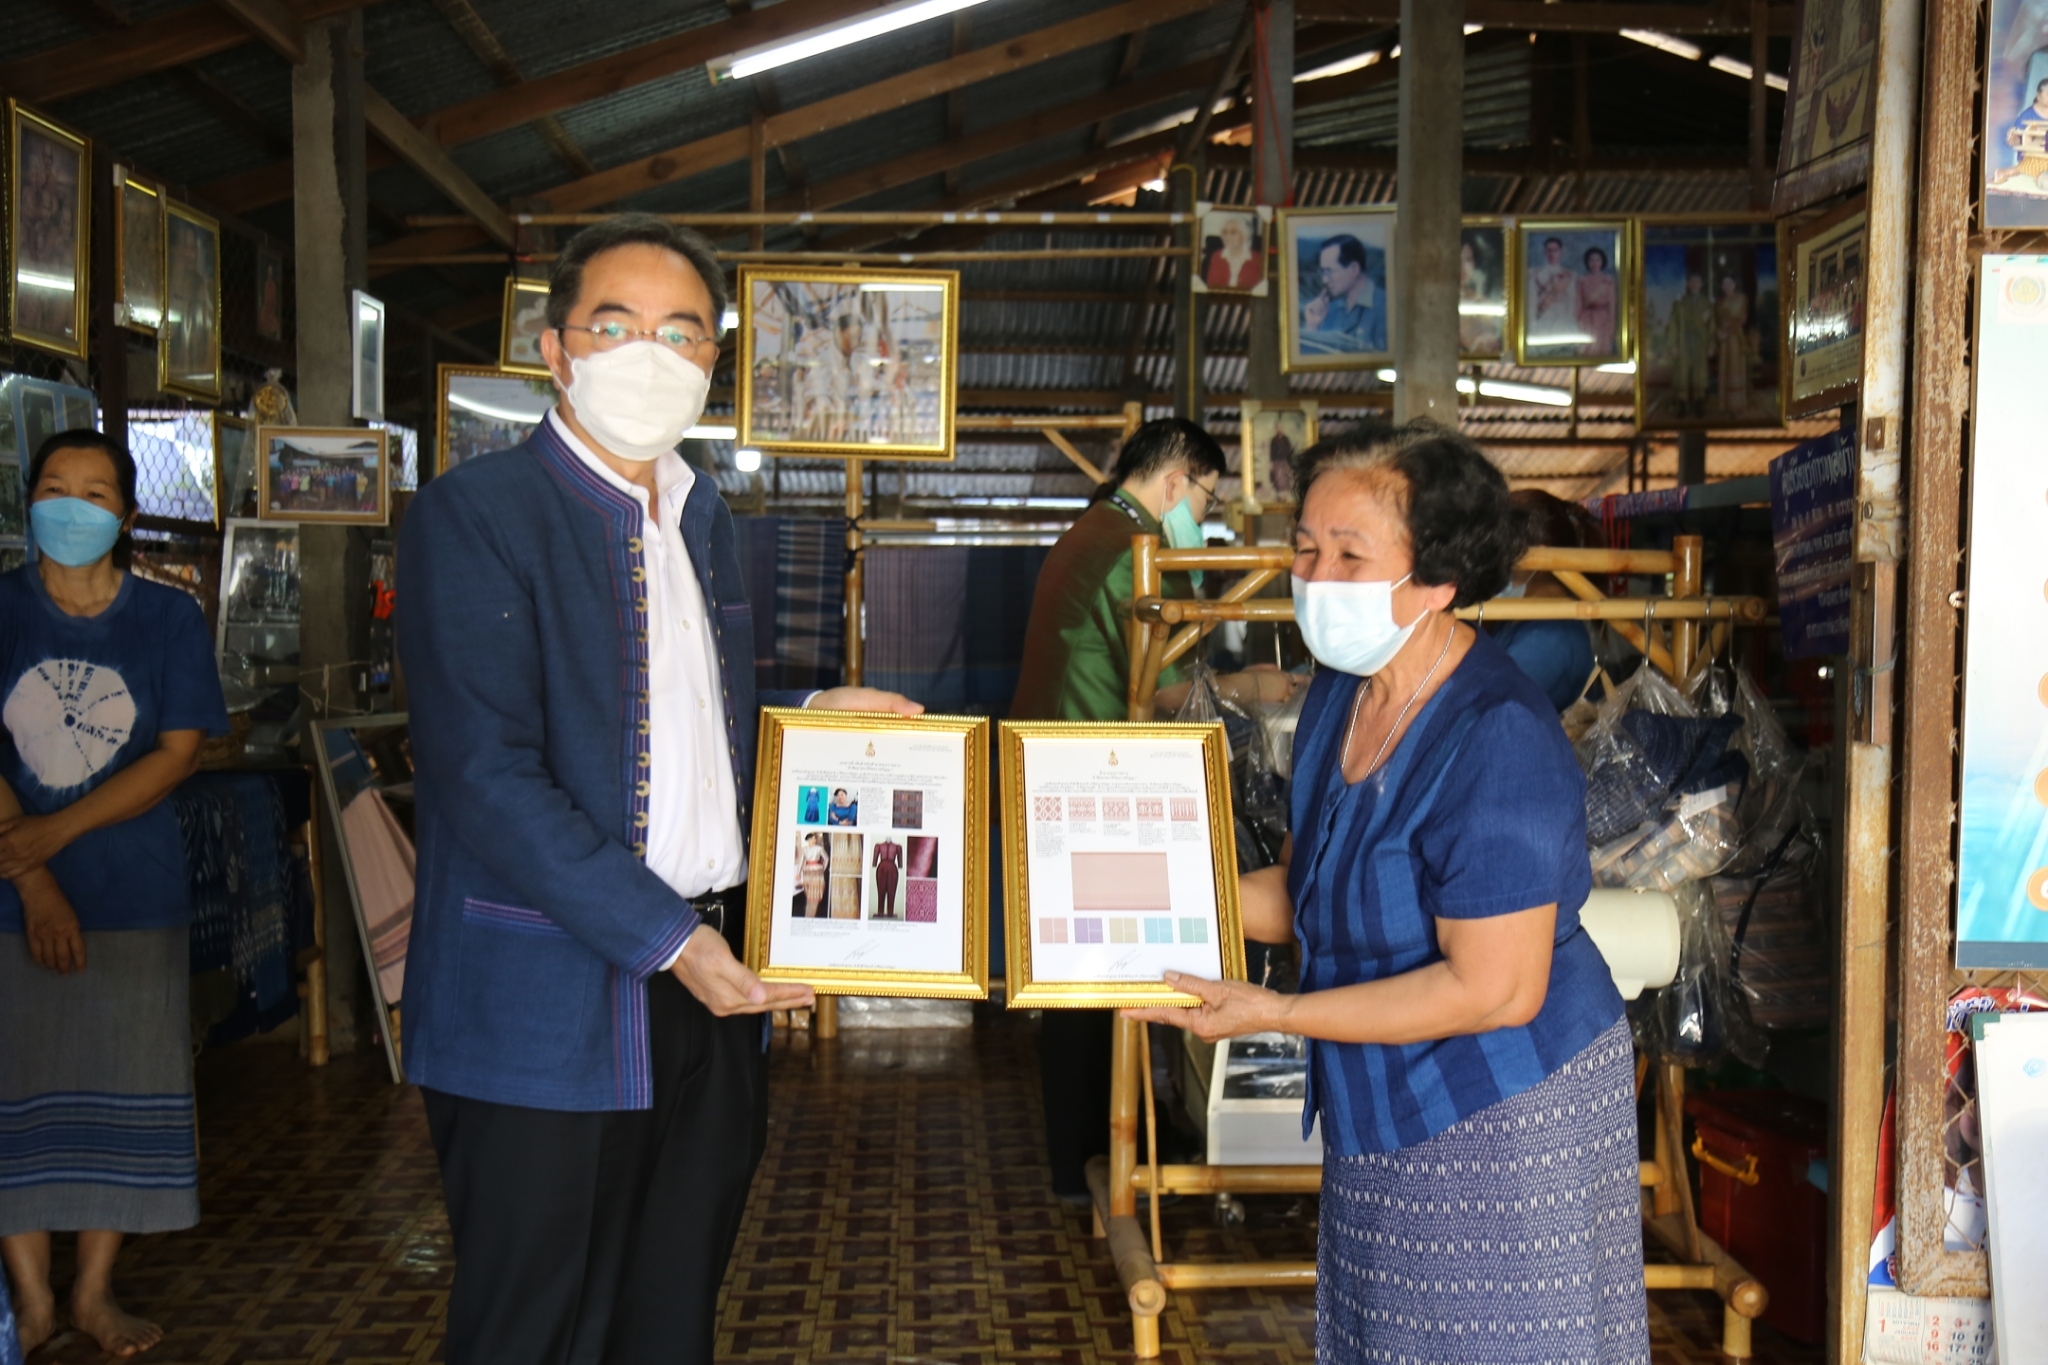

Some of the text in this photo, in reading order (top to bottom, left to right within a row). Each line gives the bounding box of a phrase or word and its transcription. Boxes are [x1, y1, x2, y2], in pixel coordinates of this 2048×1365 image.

[1878, 1318, 1886, 1333] 1
[1931, 1315, 1940, 1326] 2
[1954, 1317, 1963, 1329] 3
[1978, 1320, 1986, 1331] 4
[1931, 1329, 1986, 1343] 9 10 11
[1926, 1341, 1985, 1355] 16 17 18
